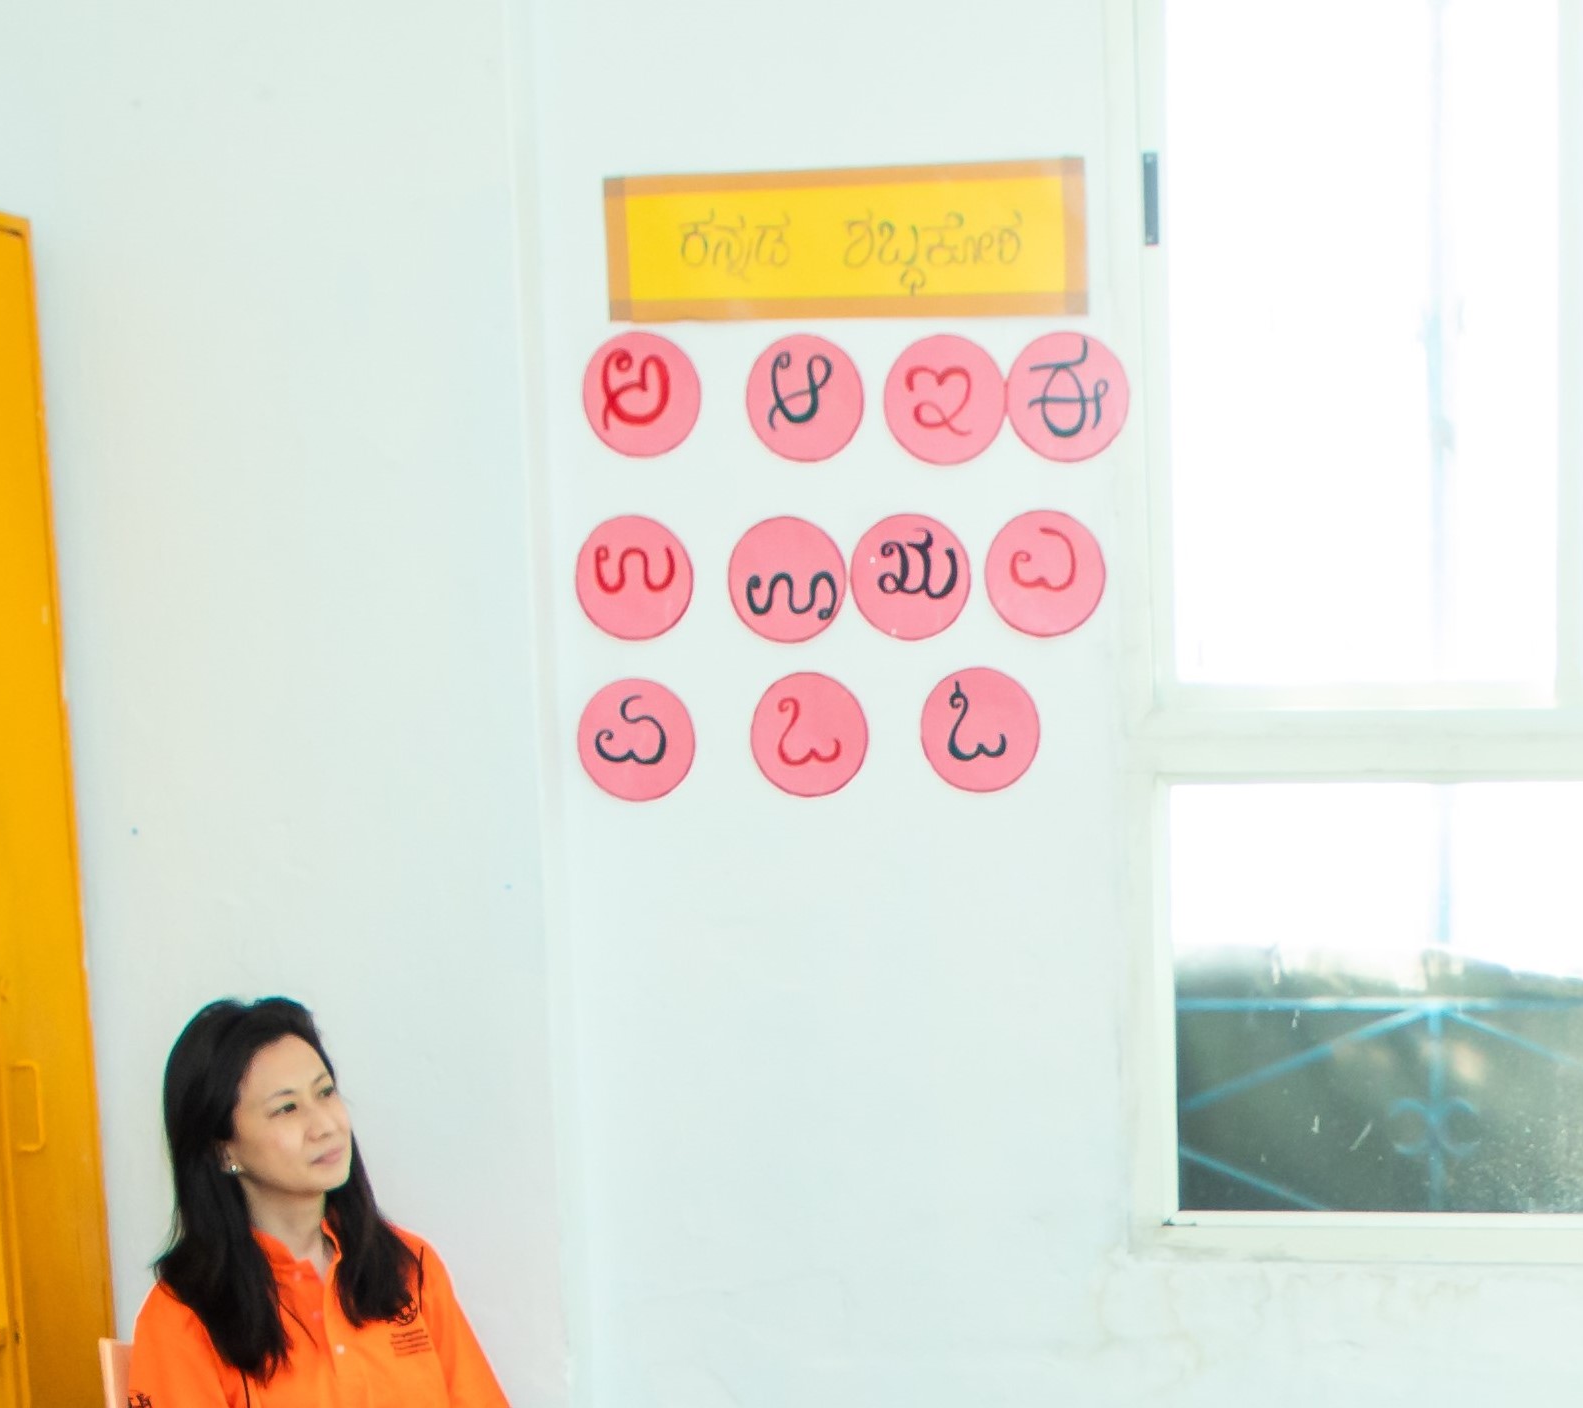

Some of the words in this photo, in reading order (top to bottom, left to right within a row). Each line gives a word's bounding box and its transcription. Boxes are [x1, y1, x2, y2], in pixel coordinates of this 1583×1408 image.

[601, 347, 671, 431] ಅ
[767, 350, 834, 432] ಆ
[903, 363, 973, 437] ಇ
[1027, 337, 1110, 438] ಈ
[594, 543, 677, 595] ಉ
[744, 570, 839, 621] ಊ
[1008, 526, 1079, 592] ಎ
[776, 695, 843, 767] ಒ
